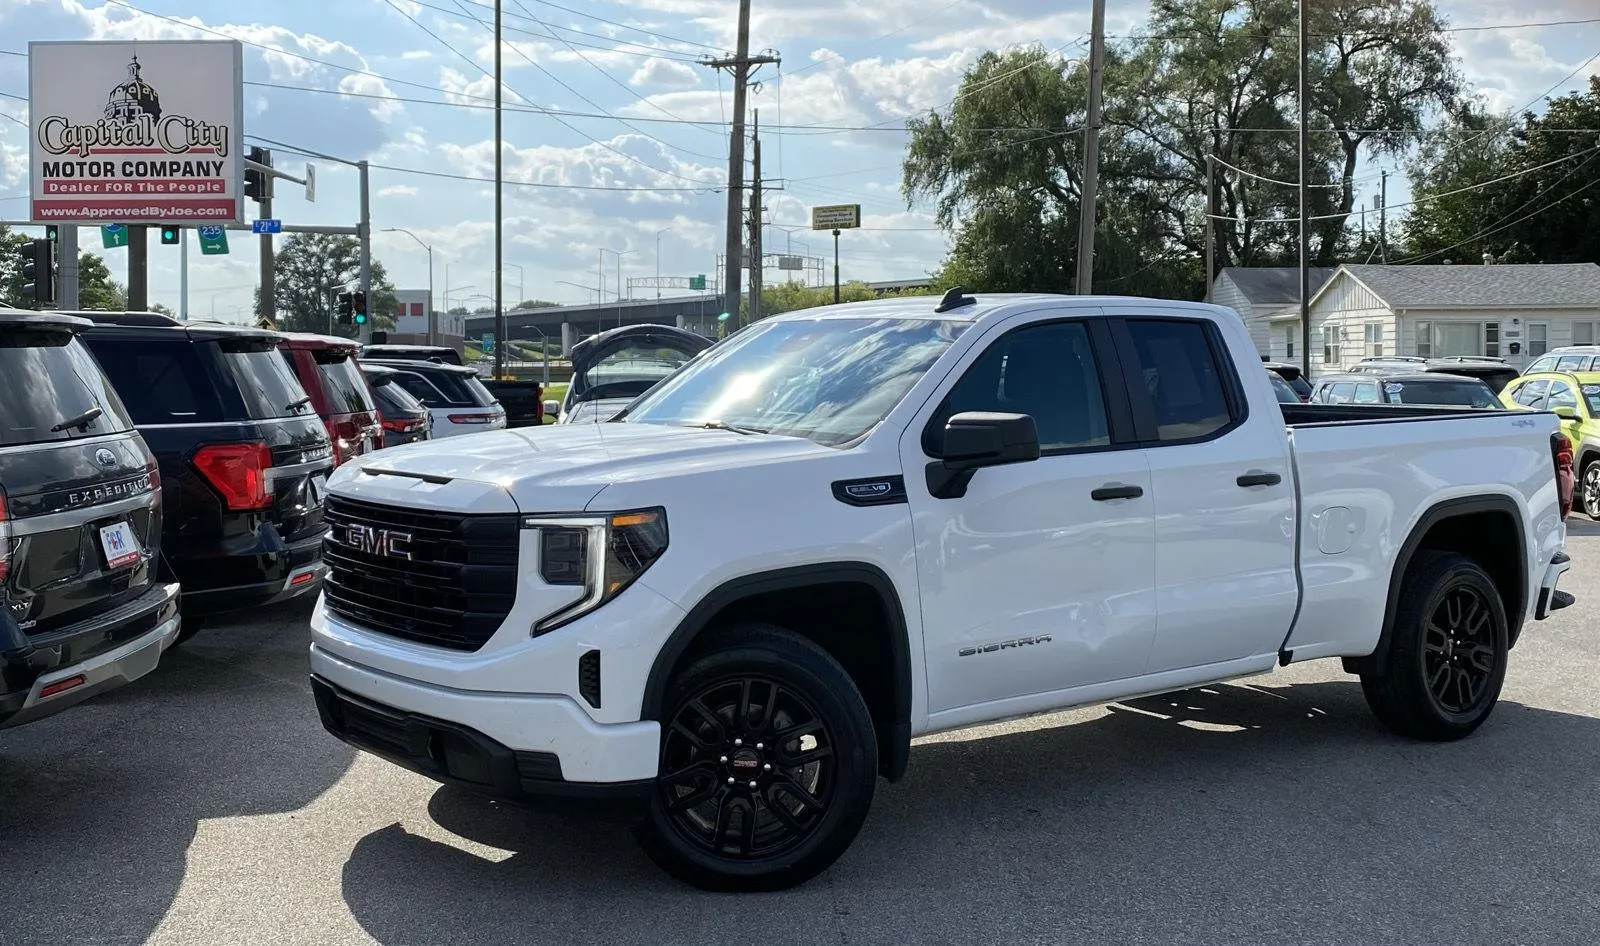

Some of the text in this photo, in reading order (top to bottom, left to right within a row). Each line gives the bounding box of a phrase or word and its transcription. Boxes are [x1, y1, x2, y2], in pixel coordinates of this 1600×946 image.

[38, 114, 229, 159] Capital City
[42, 160, 225, 178] MOTOR COMPANY
[49, 181, 221, 193] Dealer FOR The People
[40, 205, 227, 219] www.ApprovedByJoe.com
[202, 226, 221, 235] 235
[346, 523, 412, 561] GMC
[11, 602, 29, 611] XLT
[958, 633, 1053, 657] SIERRA
